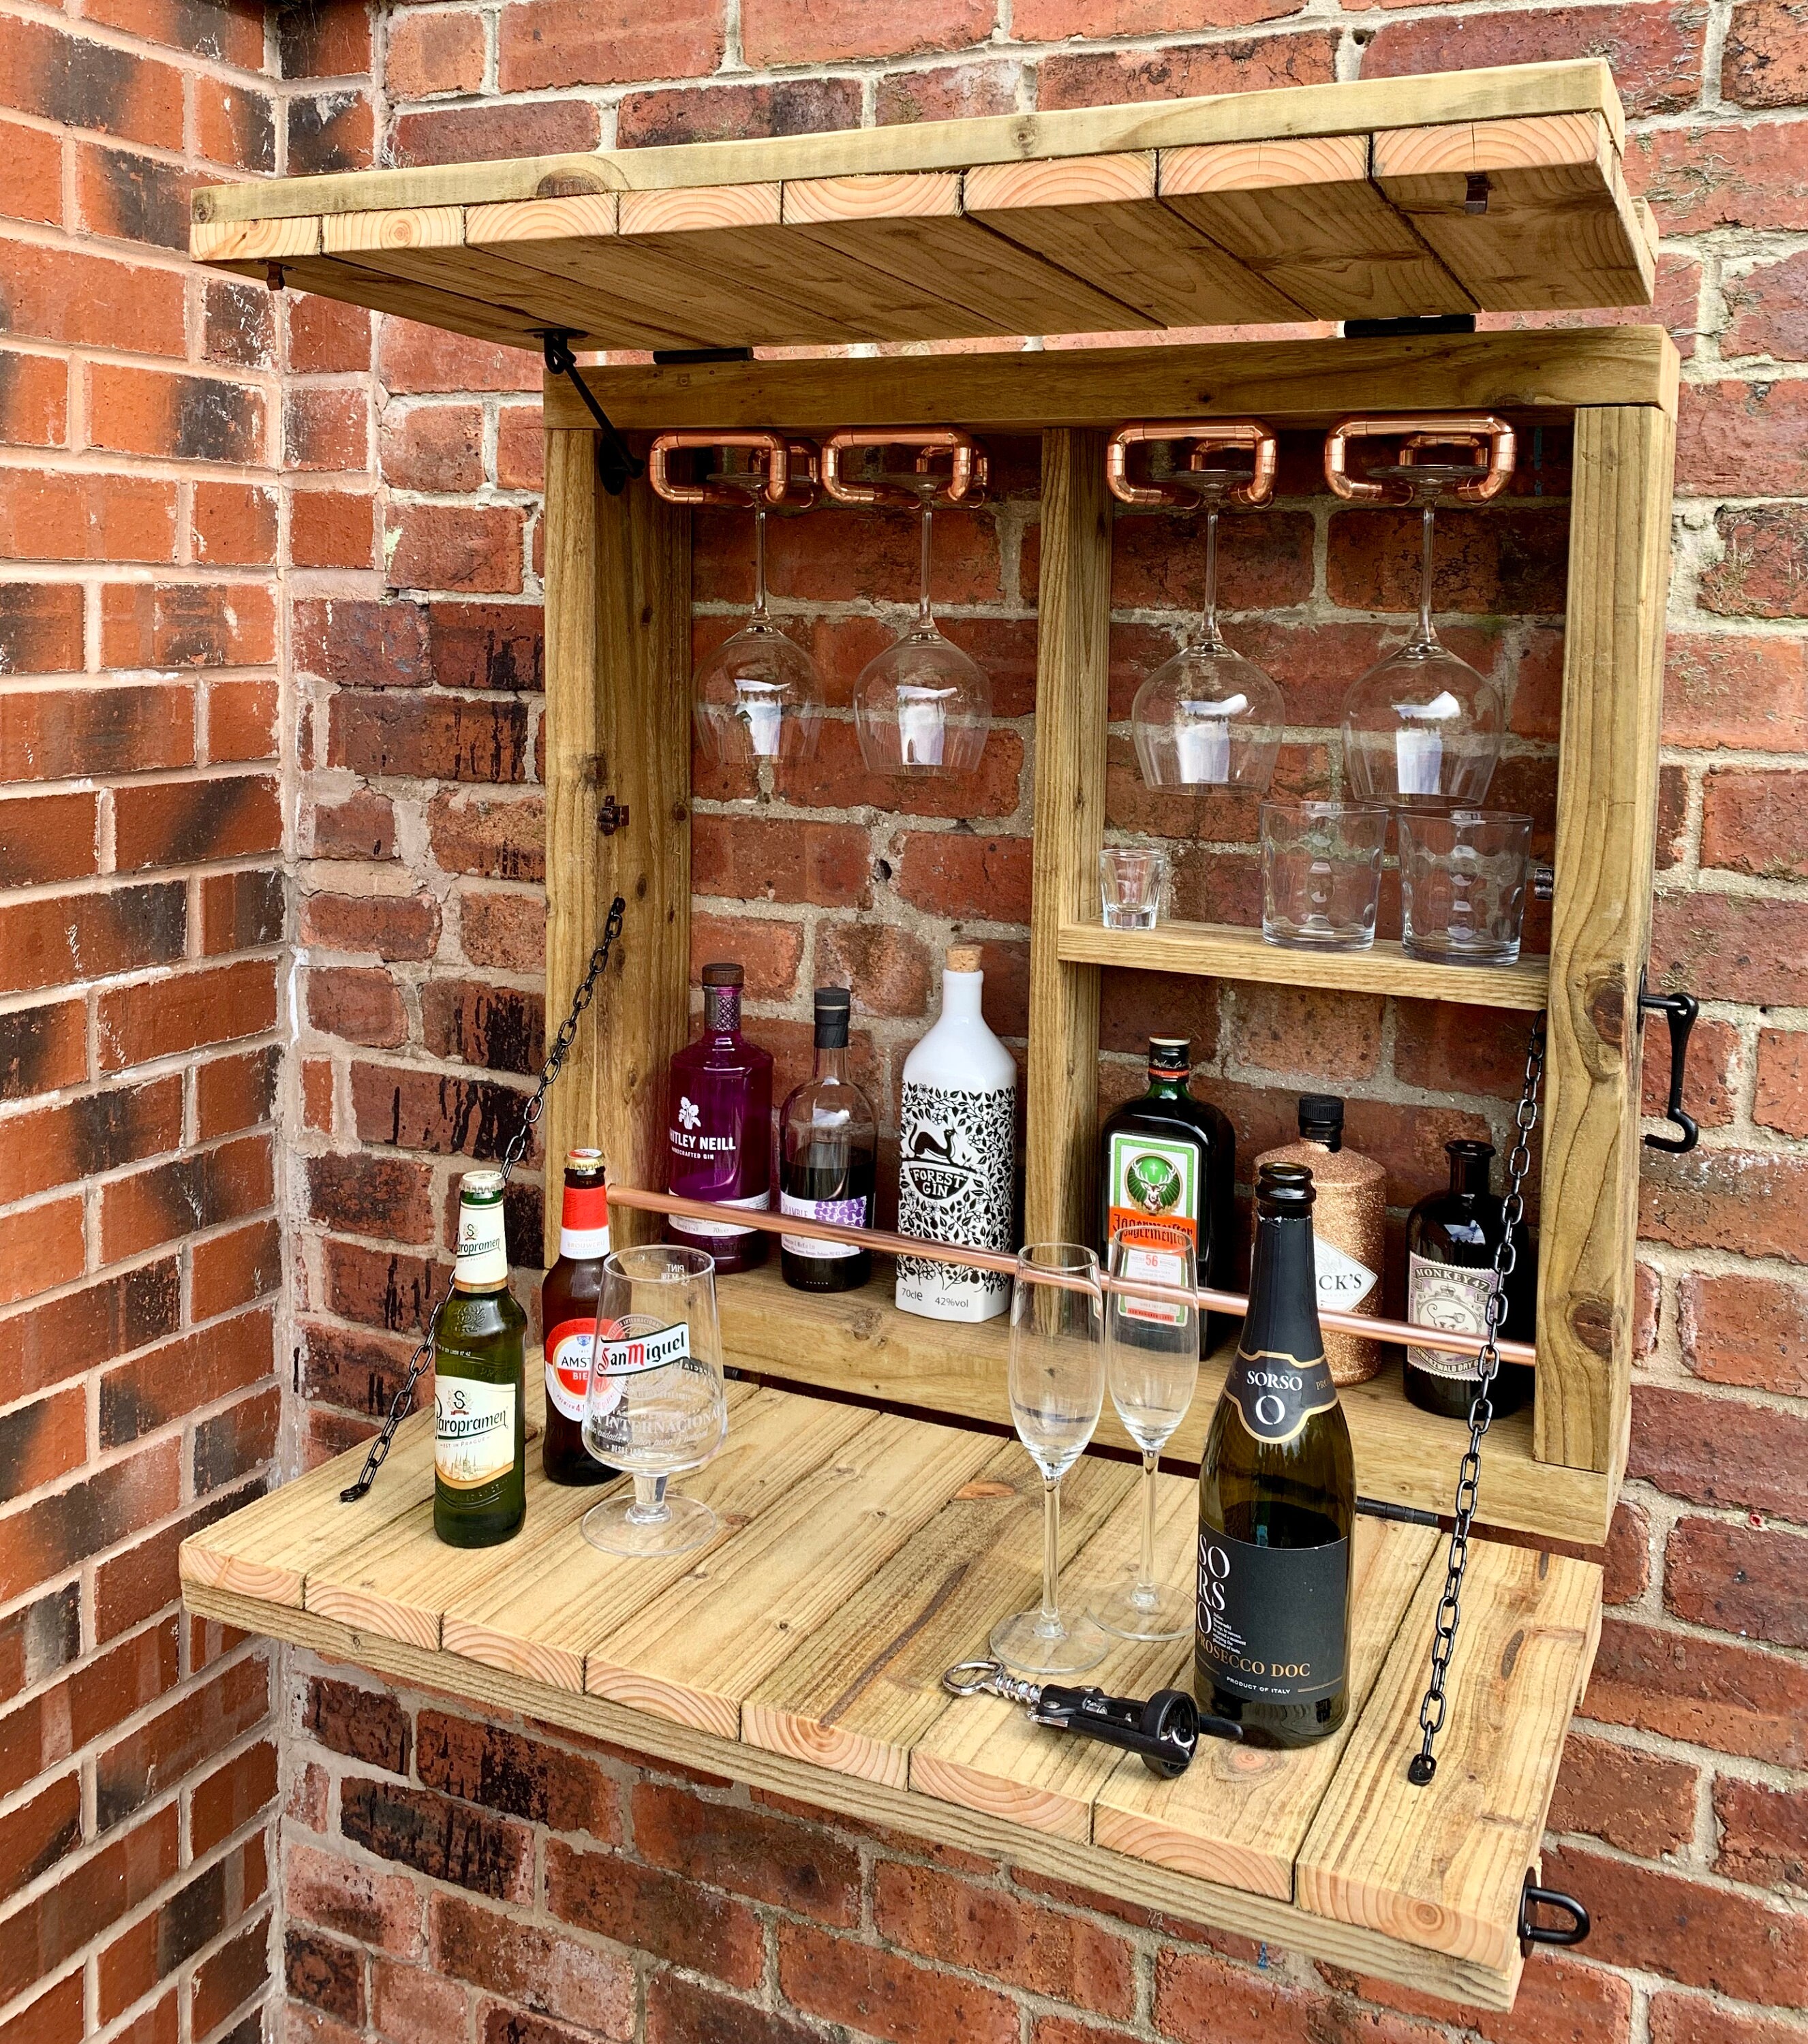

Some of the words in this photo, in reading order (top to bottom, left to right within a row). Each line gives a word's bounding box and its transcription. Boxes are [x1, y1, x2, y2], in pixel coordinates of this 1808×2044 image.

[700, 1136, 736, 1151] NEILL
[913, 1169, 964, 1188] FOREST
[922, 1181, 949, 1198] GIN
[1146, 1254, 1159, 1267] 56
[1416, 1268, 1471, 1284] MONKEY
[1473, 1280, 1488, 1290] 47
[561, 1356, 592, 1368] AMST
[1458, 1361, 1472, 1372] DRY
[572, 1372, 589, 1381] BIE
[1247, 1371, 1303, 1391] SORSO
[1255, 1395, 1285, 1425] O
[1197, 1628, 1266, 1675] PROSECCO
[1270, 1662, 1311, 1678] DOC
[1226, 1675, 1257, 1691] PRODUCT
